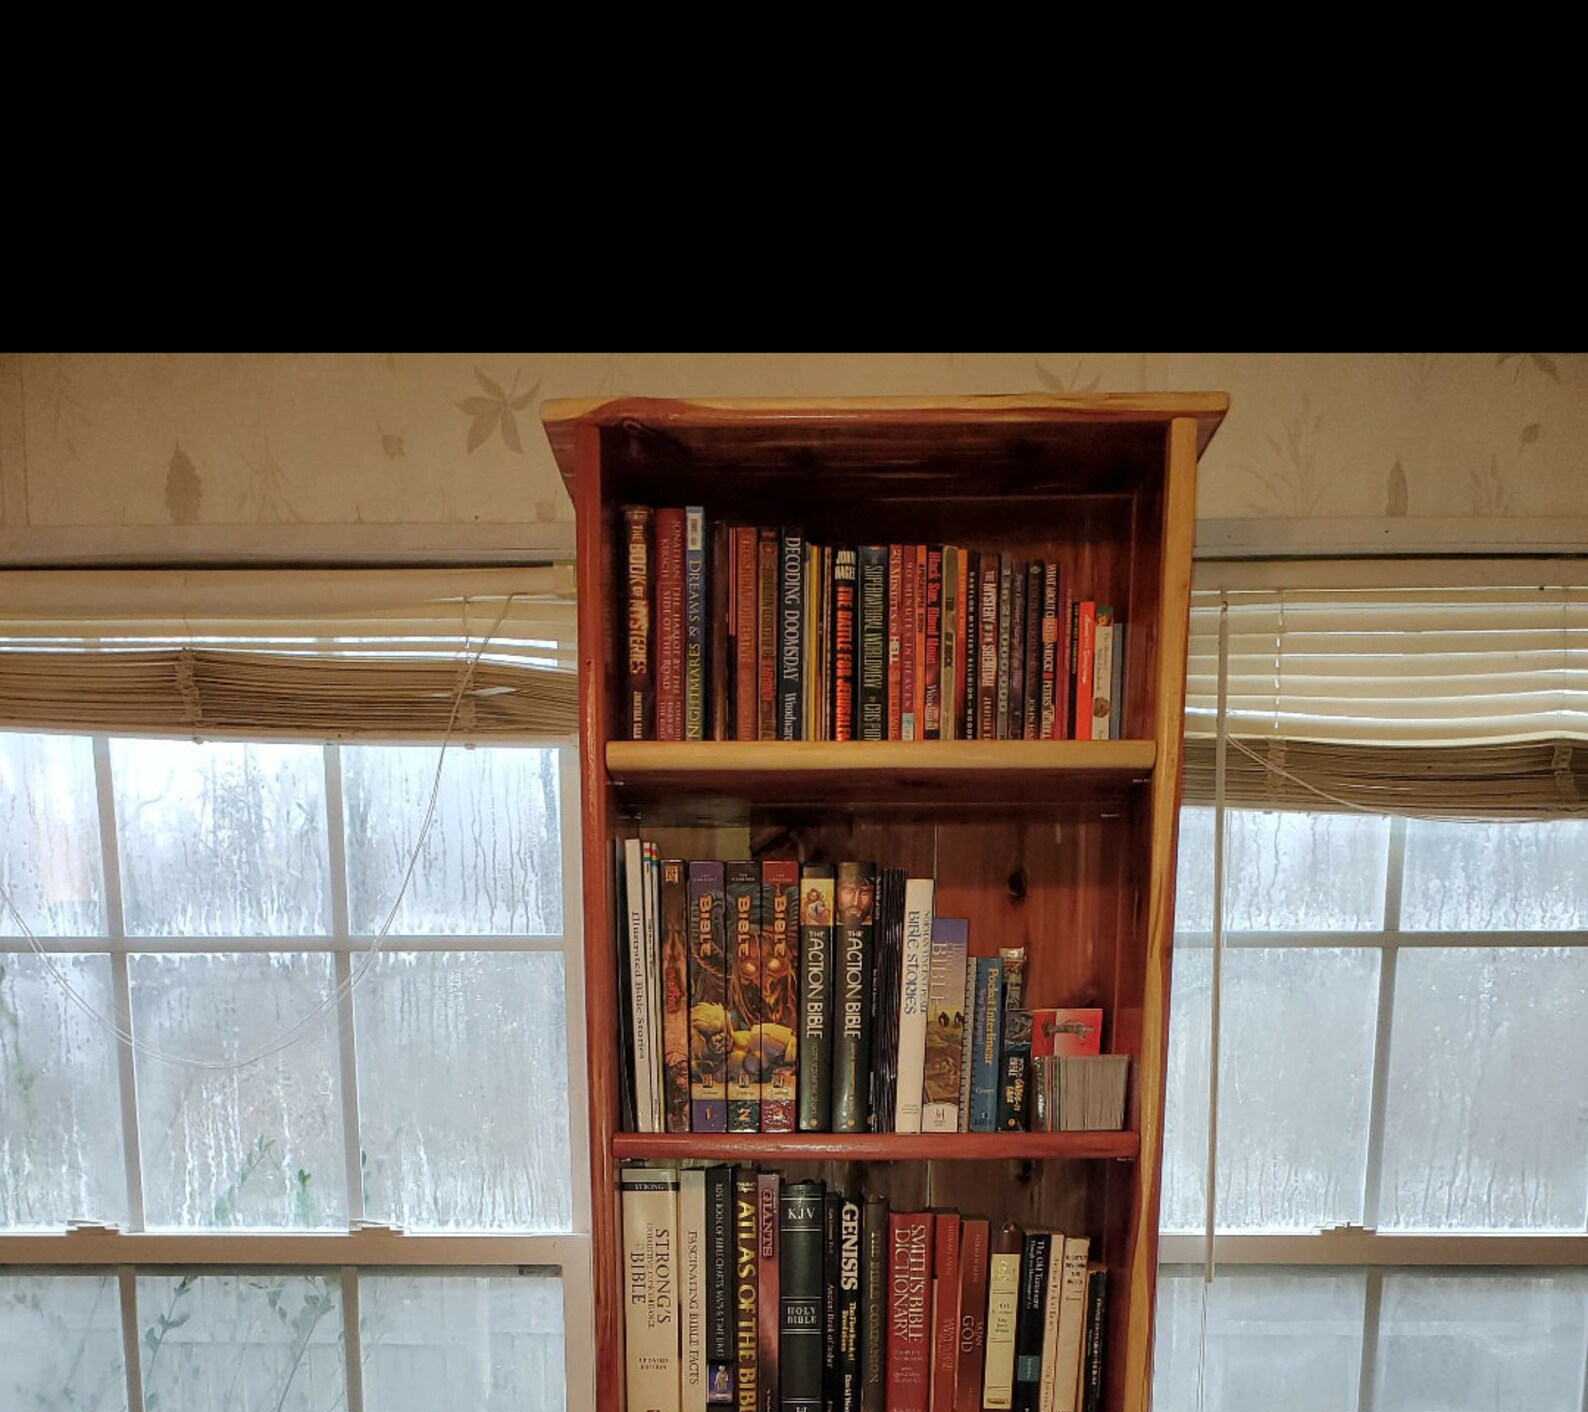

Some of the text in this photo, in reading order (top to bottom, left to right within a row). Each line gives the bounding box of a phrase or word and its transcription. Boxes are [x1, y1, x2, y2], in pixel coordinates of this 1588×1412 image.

[660, 539, 669, 578] KIRSCH
[835, 551, 856, 564] JOHN
[905, 562, 913, 577] 90
[928, 552, 940, 579] Black
[1046, 564, 1057, 586] WHAT
[629, 526, 649, 675] THE BOOK OF MYSTERIES
[689, 560, 701, 622] DREAMS
[784, 537, 801, 682] DECODING DOOMSDAY
[863, 565, 884, 631] SUPERNATURAL
[890, 568, 899, 619] MINUTES
[905, 583, 913, 638] MINUTES
[982, 583, 996, 623] MYSTERY
[1046, 587, 1056, 610] ABOUT
[660, 590, 671, 691] SIDE OF THE ROAD
[673, 587, 681, 695] THE HARLOT BY THE
[689, 626, 701, 638] &
[837, 586, 853, 676] THE BATTLE FOR
[889, 636, 899, 665] HELL
[890, 622, 898, 633] IN
[905, 643, 913, 655] IN
[967, 571, 976, 699] BABYLON MYSTERY RELIGION
[688, 643, 701, 738] NIGHTMARES
[904, 660, 912, 708] HEAVEN
[700, 895, 712, 957] BIBLE
[738, 895, 751, 957] BIBLE
[773, 894, 786, 957] BIBLE
[632, 910, 647, 1060] Illustrated Bible Stories
[807, 938, 824, 998] ACTION
[844, 939, 862, 1038] ACTION BIBLE
[905, 910, 920, 1015] BIBLE STORIES
[920, 910, 931, 1016] NORMAN VINCENT PEALE
[930, 941, 948, 1005] BIBLE
[806, 1003, 824, 1038] BIBLE
[984, 968, 999, 1065] Pocket Interlinear
[705, 1107, 711, 1118] 1
[739, 1107, 750, 1121] 2
[634, 1183, 664, 1191] STRONG
[715, 1203, 725, 1222] BOOK
[715, 1224, 725, 1235] OF
[737, 1199, 756, 1278] ATLAS
[762, 1188, 773, 1257] GIANTS
[787, 1208, 816, 1220] KJV
[841, 1203, 859, 1290] GENISIS
[909, 1224, 926, 1295] SMITH'S
[1035, 1241, 1045, 1272] The Old
[631, 1251, 646, 1305] BIBLE
[655, 1228, 671, 1325] STRONG'S
[738, 1284, 755, 1313] OF
[893, 1228, 911, 1342] DICTIONARY
[688, 1231, 700, 1385] FASCINATING BIBLE FACTS
[787, 1307, 816, 1316] HOLY
[787, 1315, 816, 1324] BIBLE
[868, 1231, 881, 1383] THE BIBLE COMPANION
[908, 1296, 924, 1344] BIBLE
[738, 1317, 756, 1364] THE
[962, 1315, 975, 1353] GOD
[975, 1320, 984, 1347] SATAN
[843, 1374, 853, 1398] David
